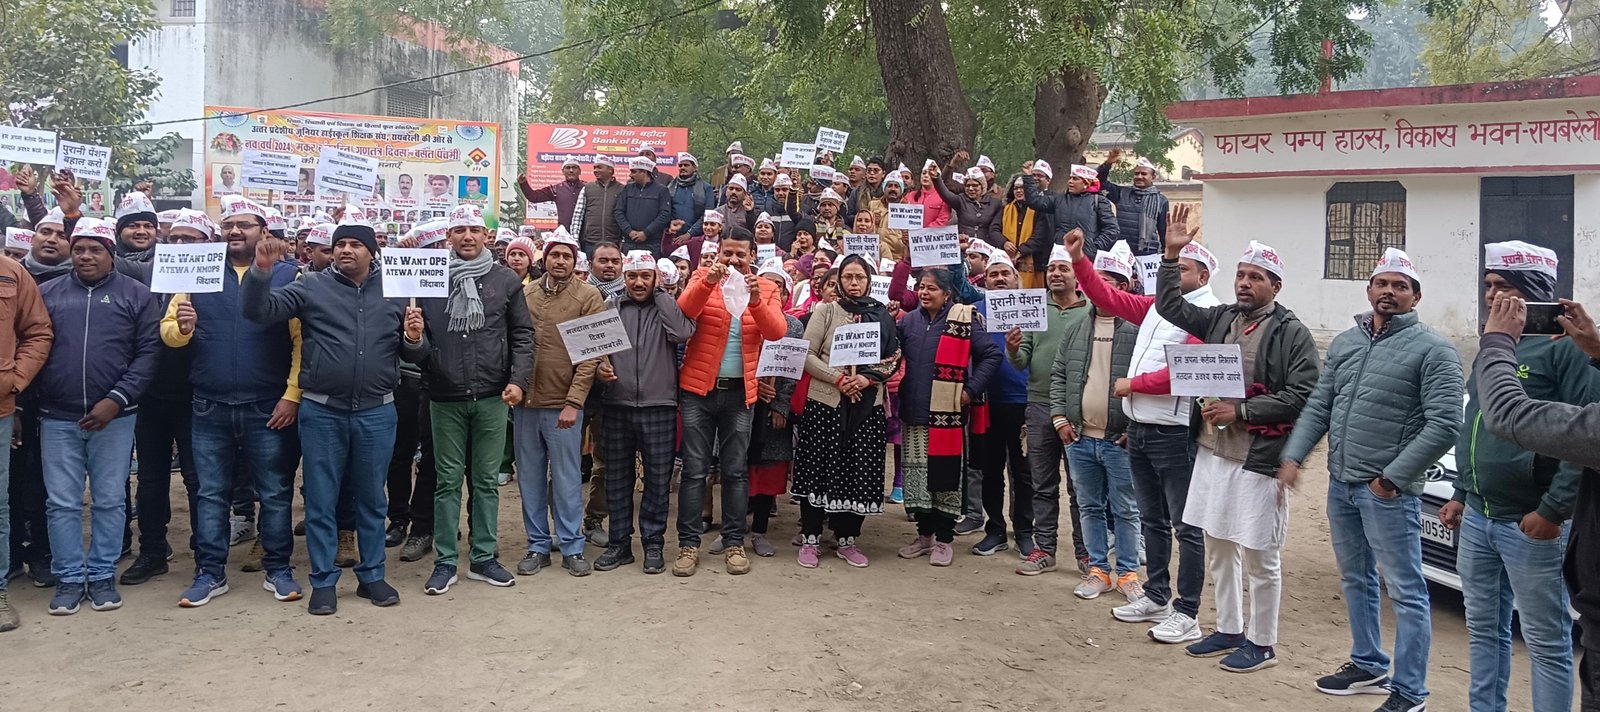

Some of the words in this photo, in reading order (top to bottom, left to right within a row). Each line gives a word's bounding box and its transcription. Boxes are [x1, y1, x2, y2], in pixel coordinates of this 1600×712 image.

[295, 126, 320, 138] जूनियर
[351, 130, 374, 140] शिक्षक
[391, 132, 420, 142] रायबरेली
[421, 133, 432, 143] की
[432, 134, 445, 144] ओर
[446, 135, 453, 144] से
[592, 136, 618, 144] Bank
[620, 136, 631, 145] of
[1214, 132, 1274, 155] फायर
[1282, 130, 1327, 153] पम्प
[1332, 127, 1390, 154] हाउस,
[1394, 118, 1459, 149] विकास
[62, 144, 86, 156] पुरानी
[88, 145, 107, 158] पेंशन
[244, 140, 258, 149] नव
[260, 138, 272, 150] वर्ष
[296, 142, 317, 153] मकर
[385, 145, 407, 158] दिवस
[63, 155, 85, 165] बहाल
[87, 158, 102, 168] करो
[845, 235, 862, 245] पुरानी
[911, 236, 924, 244] WE
[924, 234, 945, 242] WANT
[945, 233, 958, 241] OPS
[158, 253, 176, 263] WE
[178, 253, 206, 263] WANT
[206, 252, 224, 262] OPS
[383, 255, 398, 265] WE
[400, 256, 428, 266] WANT
[429, 256, 447, 266] OPS
[1501, 251, 1524, 267] पुरानी
[1525, 251, 1543, 266] पेंशन
[386, 268, 412, 276] ATEWA
[419, 269, 444, 277] NMOPS
[989, 296, 1016, 310] पुरानी
[1019, 293, 1042, 305] पेंशन
[993, 308, 1019, 322] बहाल
[1021, 305, 1039, 319] करो
[995, 321, 1013, 331] अटेवा
[588, 332, 606, 341] दिवस
[834, 333, 845, 342] WE
[845, 331, 866, 340] WANT
[865, 331, 879, 339] OPS
[580, 346, 597, 356] अटेवा
[597, 339, 624, 351] रायबरेली
